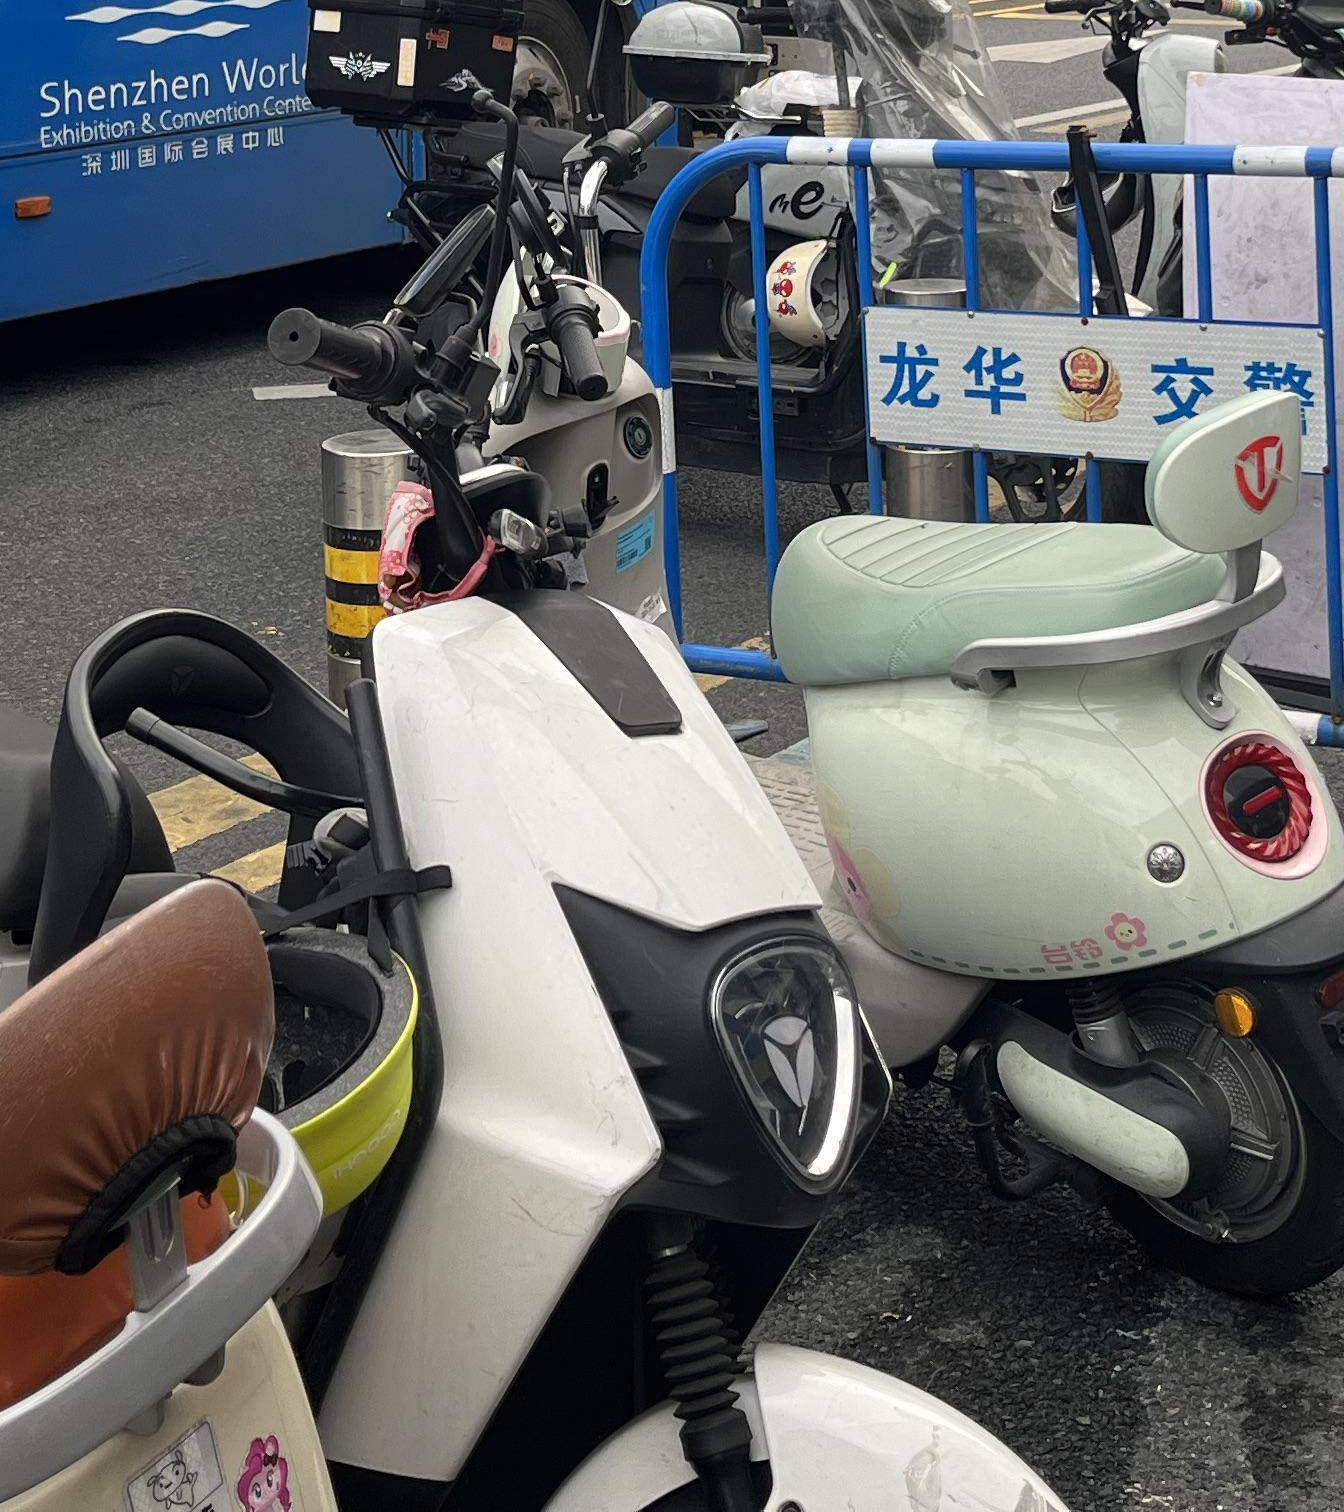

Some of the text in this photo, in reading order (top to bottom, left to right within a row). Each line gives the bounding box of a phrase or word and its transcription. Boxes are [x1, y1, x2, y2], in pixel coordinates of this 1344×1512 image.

[39, 69, 209, 118] Shenzhen
[40, 94, 313, 149] Exhibition & Convention Cente
[81, 127, 285, 177] 深圳国际会展中心
[879, 342, 1027, 416] 龙华
